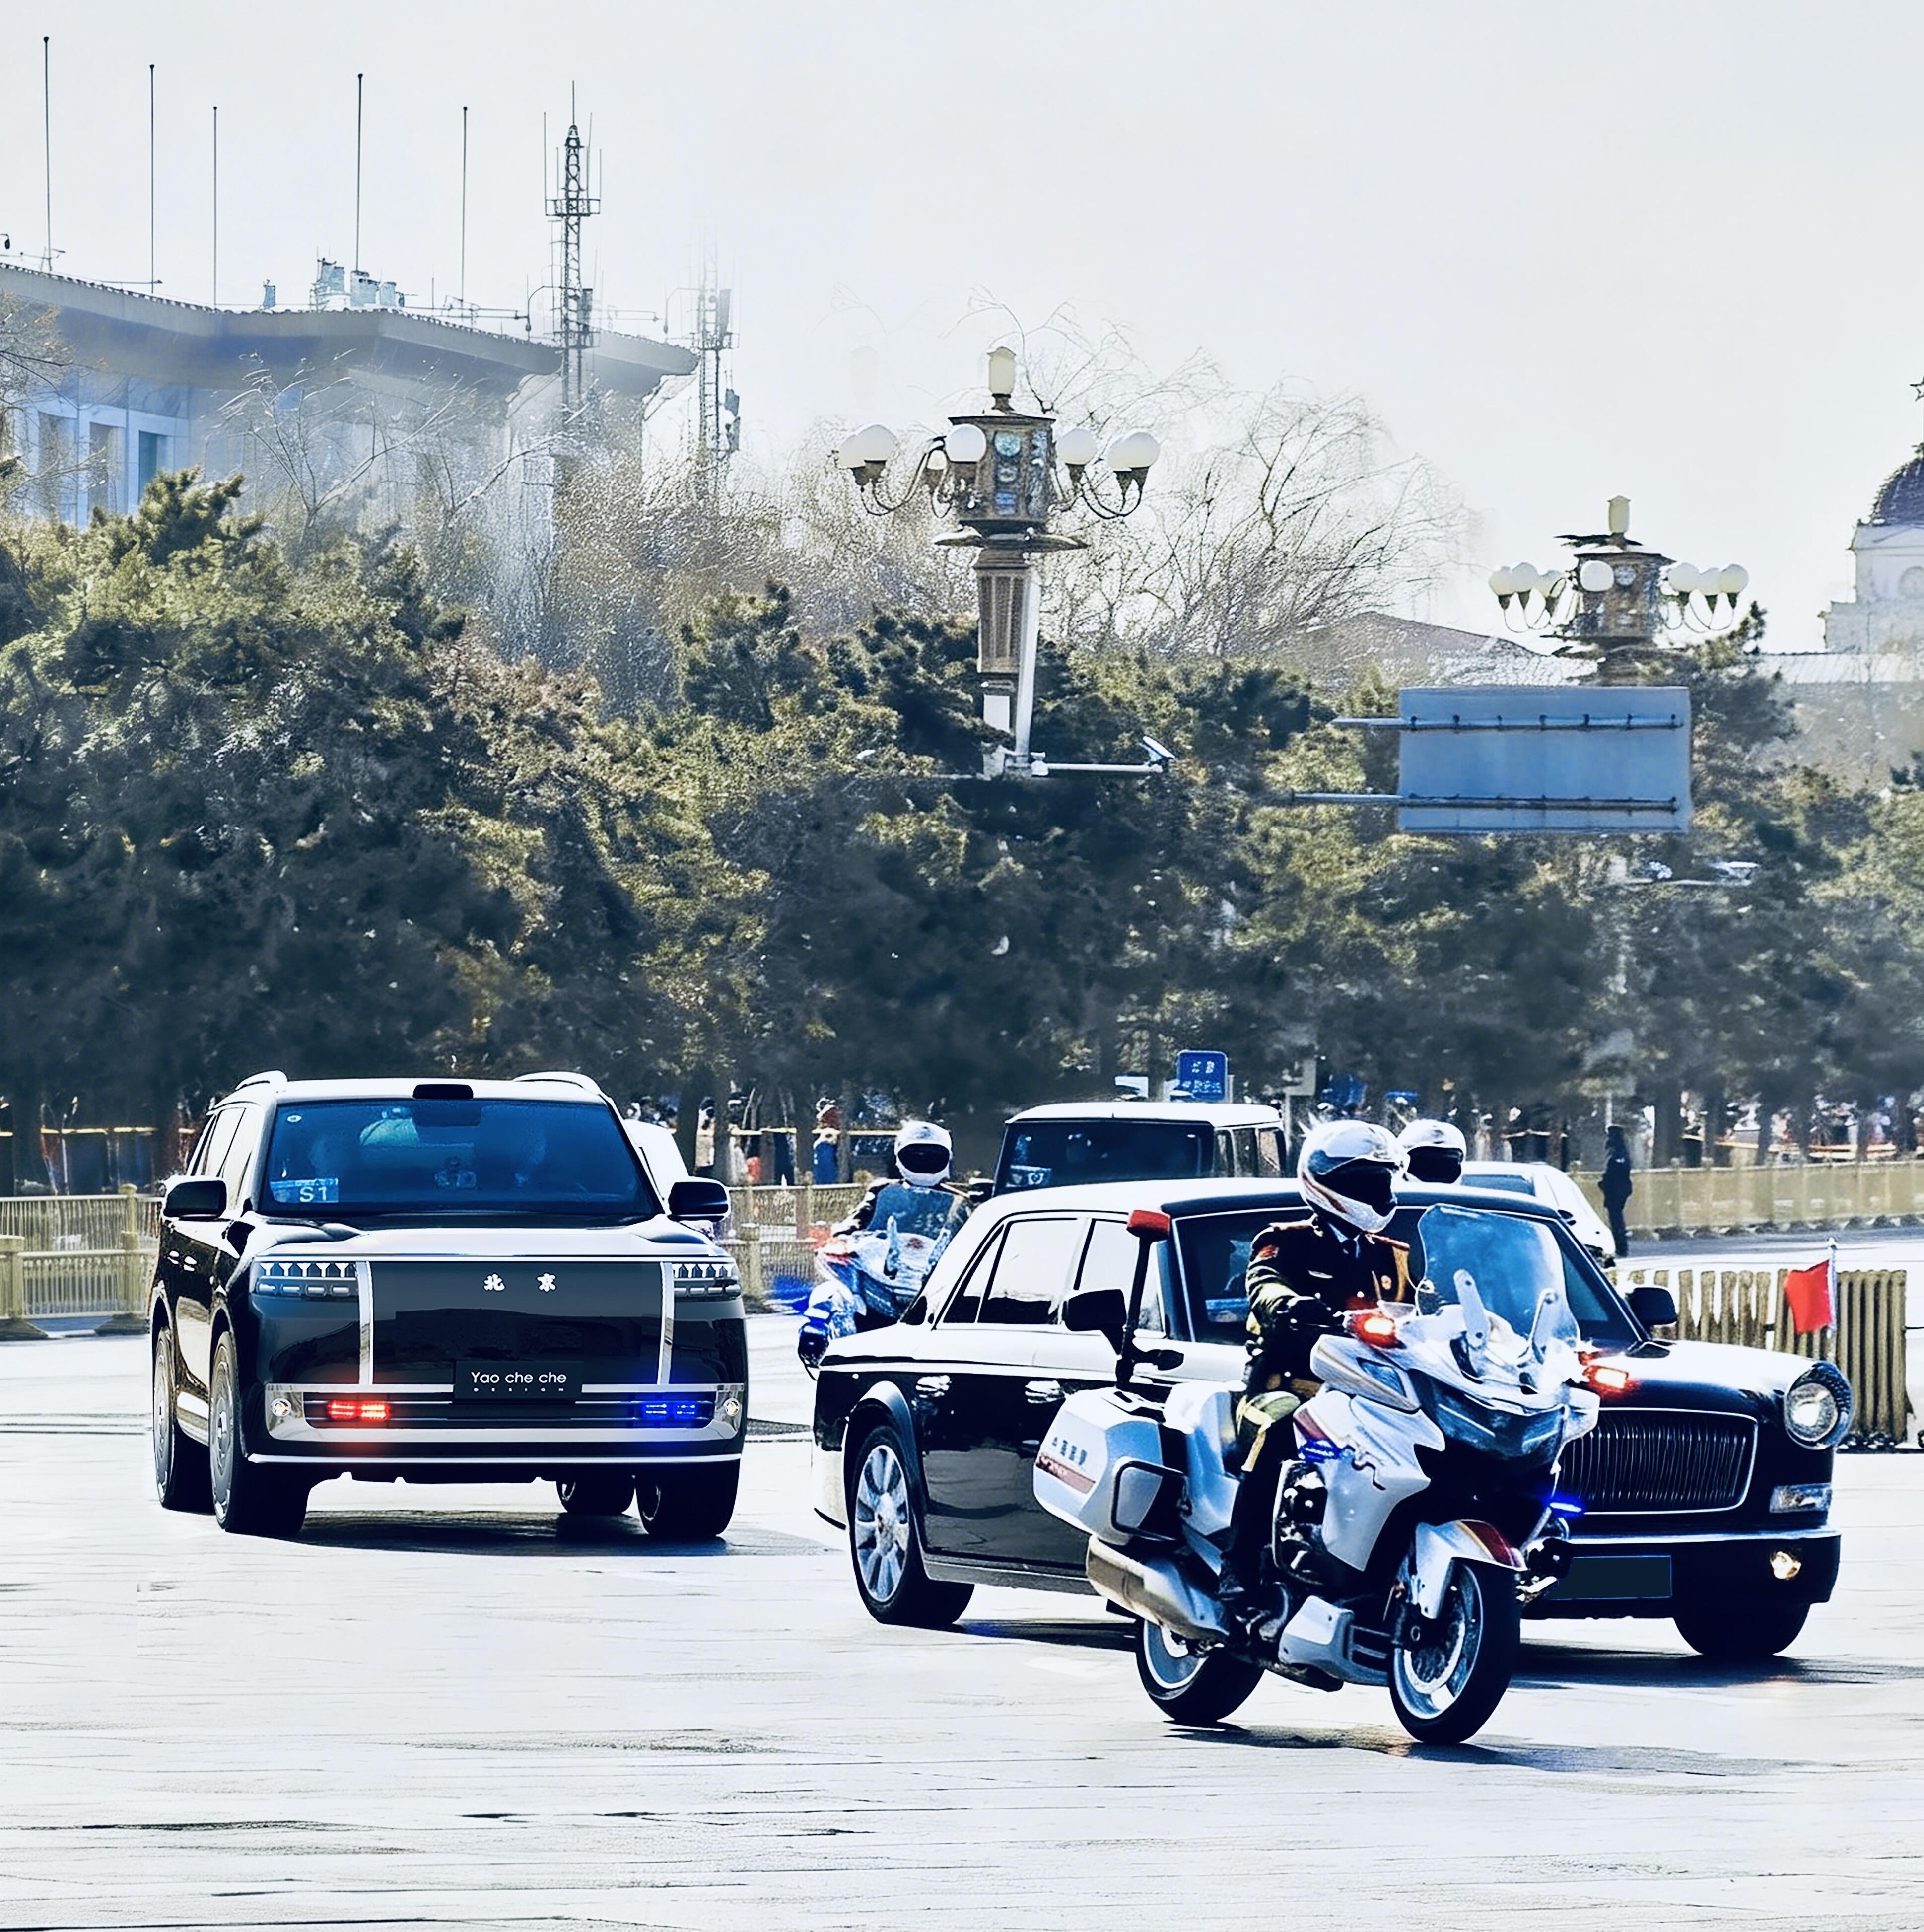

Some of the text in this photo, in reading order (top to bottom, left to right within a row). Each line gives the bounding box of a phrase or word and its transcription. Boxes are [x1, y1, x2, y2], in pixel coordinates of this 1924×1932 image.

[299, 1186, 327, 1202] S1
[484, 1273, 556, 1292] 北京
[471, 1371, 567, 1383] Yao che che
